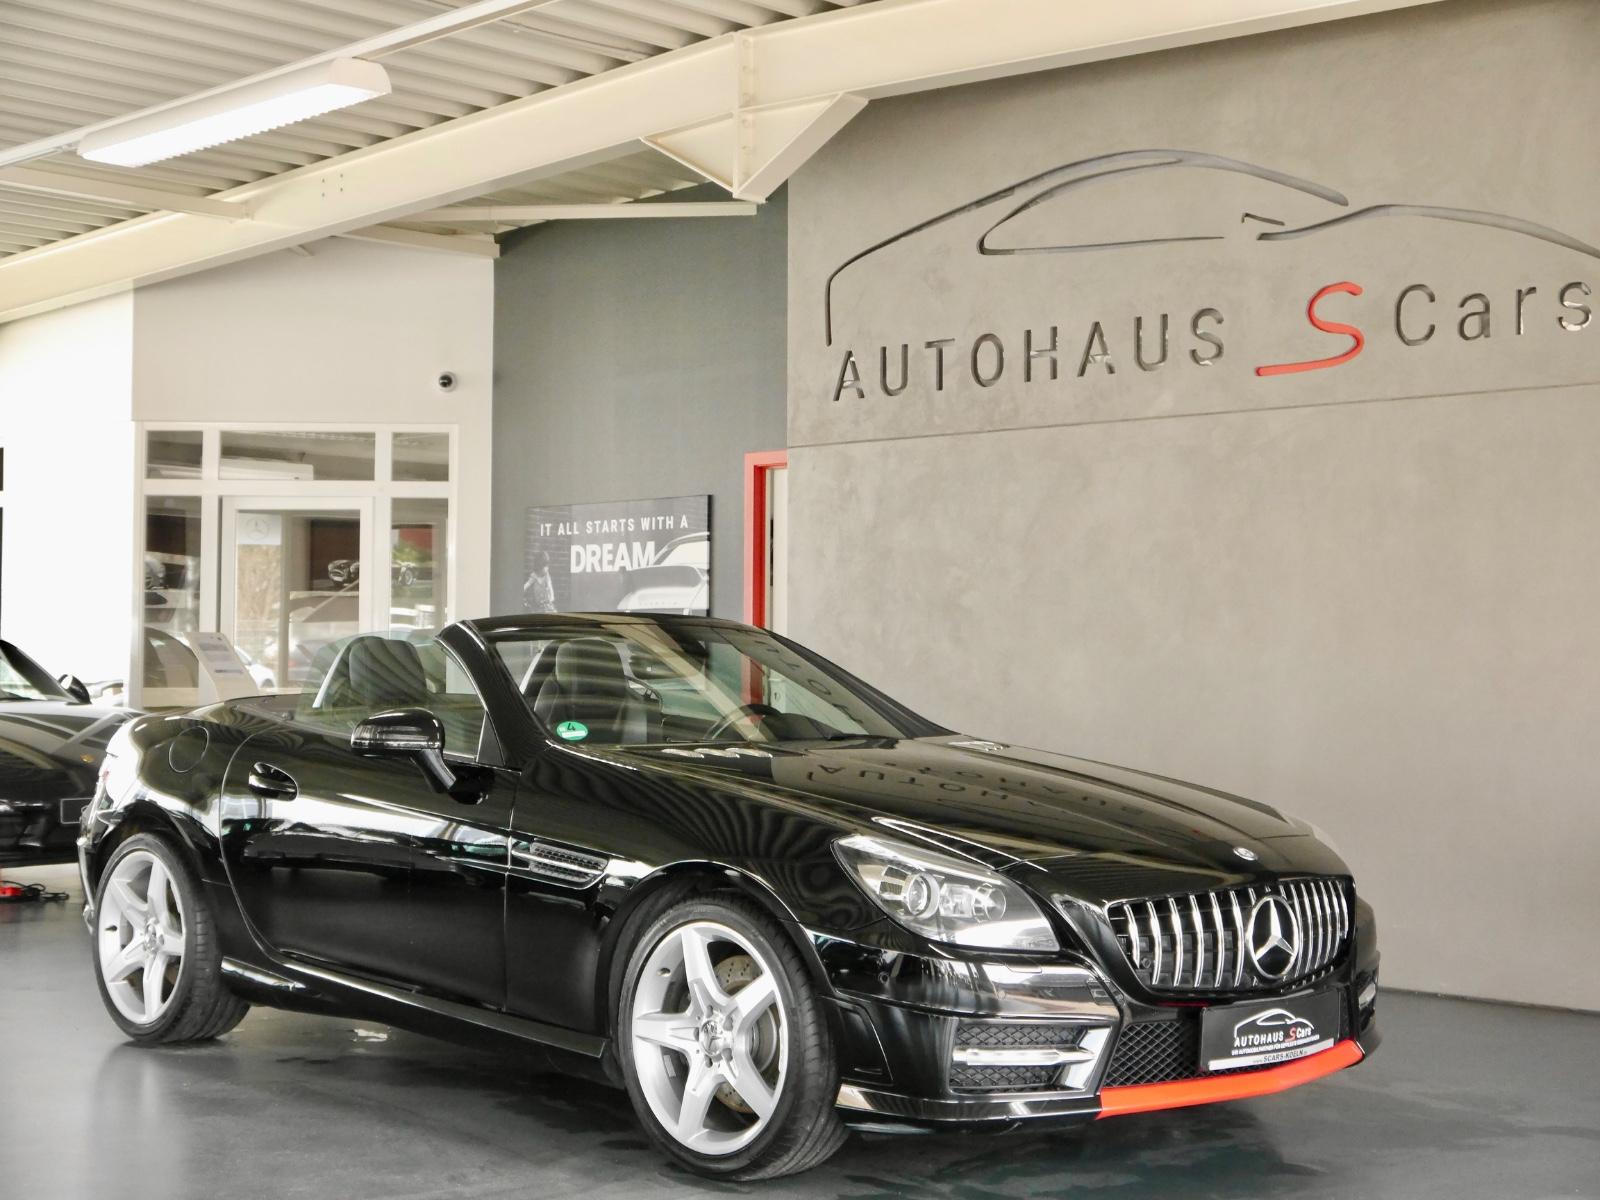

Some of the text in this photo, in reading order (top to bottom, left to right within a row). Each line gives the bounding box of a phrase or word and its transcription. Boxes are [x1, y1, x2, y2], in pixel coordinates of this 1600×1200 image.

[832, 307, 1225, 402] AUTOHAUS
[540, 514, 689, 537] IT ALL STARTS WITH A
[570, 541, 656, 573] DREAM
[1234, 1030, 1284, 1047] AUTOHAUS
